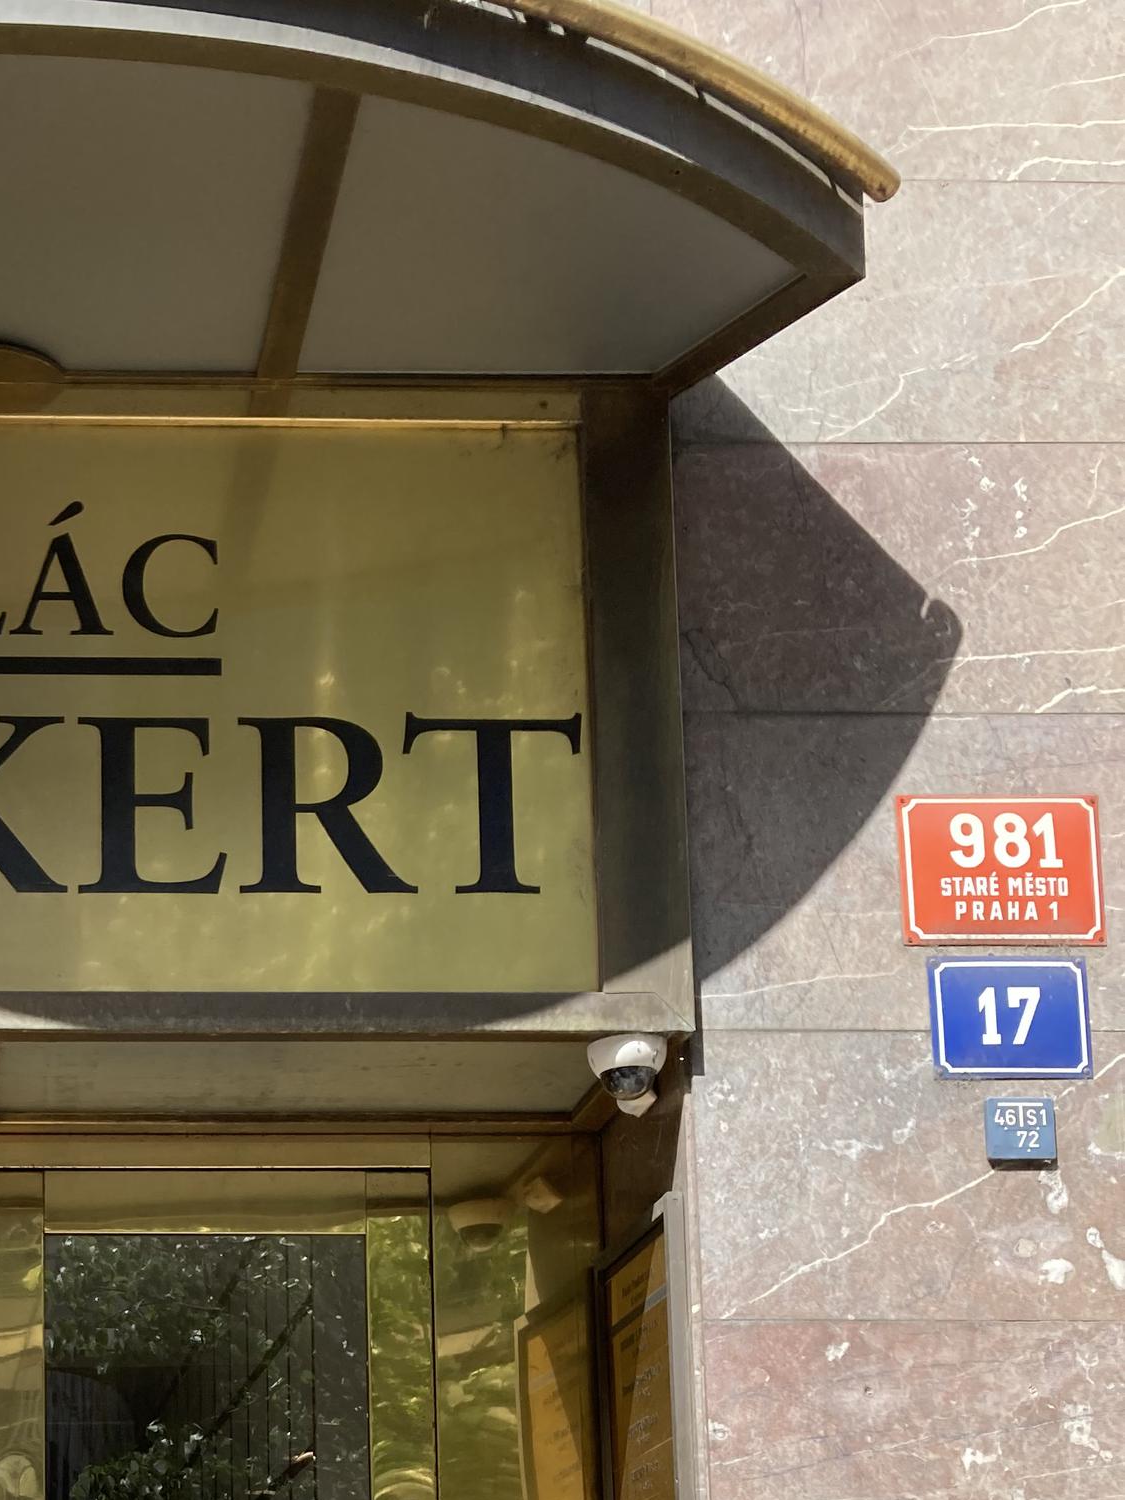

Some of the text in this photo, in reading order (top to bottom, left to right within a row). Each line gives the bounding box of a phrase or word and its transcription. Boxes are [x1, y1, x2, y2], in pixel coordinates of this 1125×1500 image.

[949, 812, 1064, 868] 981
[940, 871, 1069, 897] STARÉ MĚSTO
[954, 900, 1059, 921] PRAHA 1
[978, 986, 1041, 1046] 17
